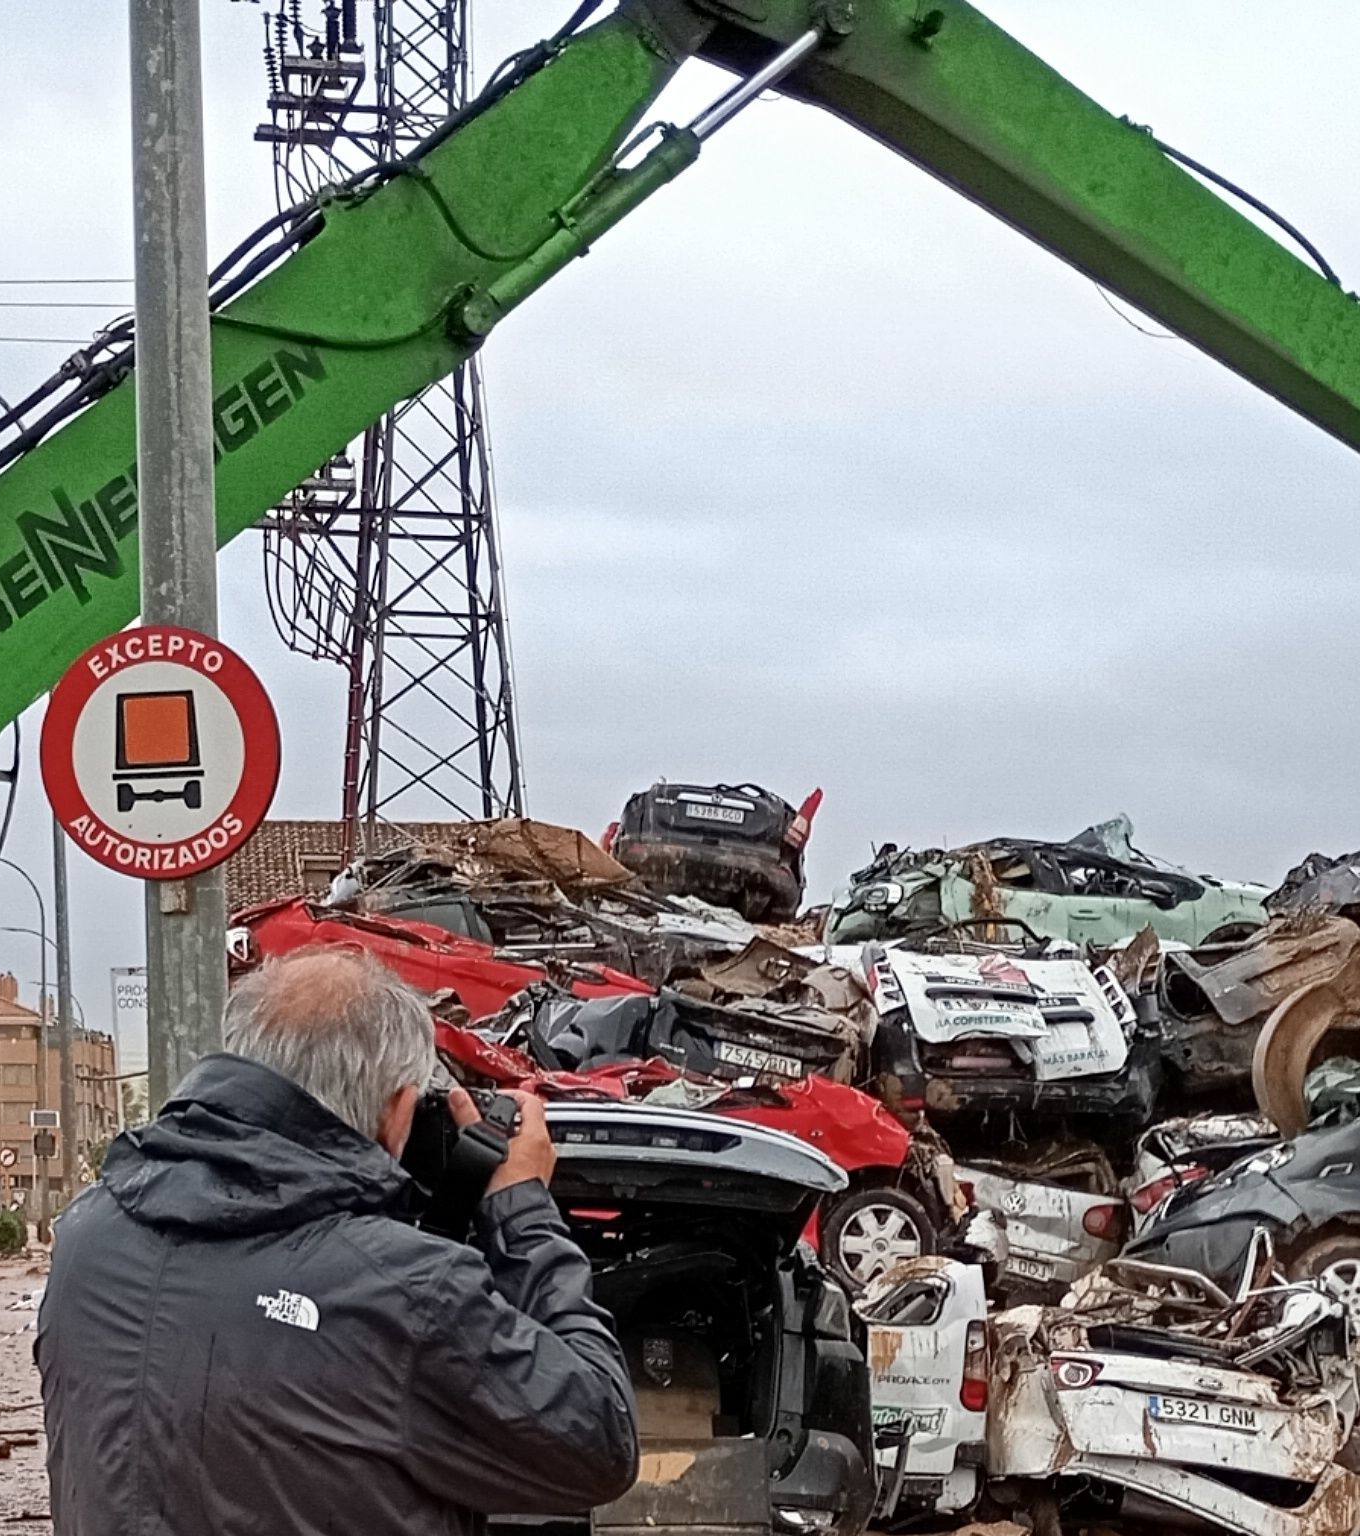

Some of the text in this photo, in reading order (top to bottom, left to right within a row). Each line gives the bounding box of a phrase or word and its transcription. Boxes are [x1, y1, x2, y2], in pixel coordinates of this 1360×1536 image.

[86, 633, 224, 679] EXCEPTO
[69, 812, 243, 870] AUTORIZADOS
[1162, 1398, 1257, 1428] 5321 GNM
